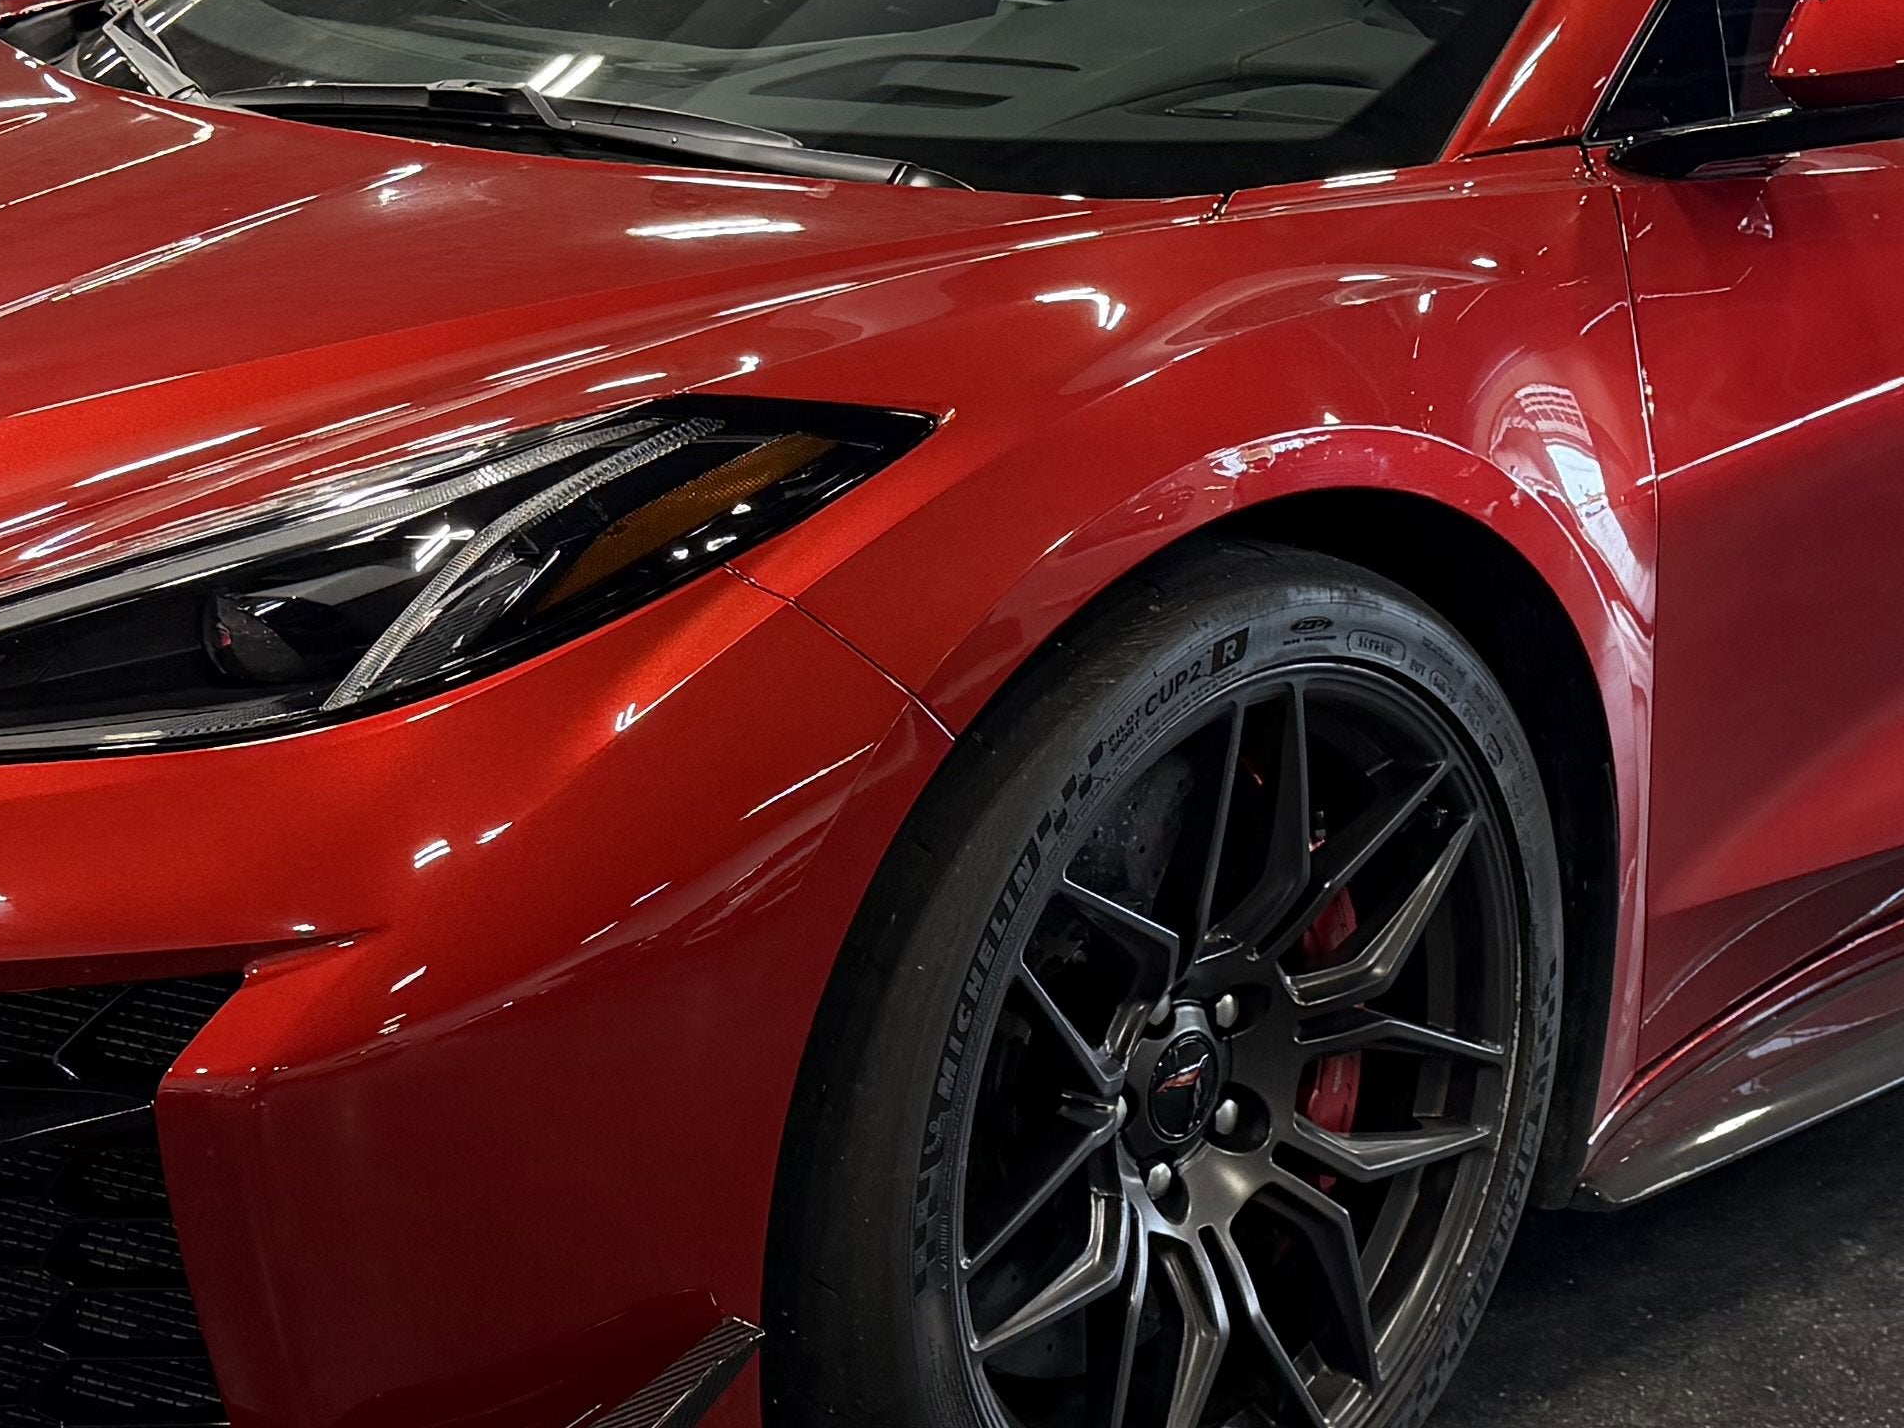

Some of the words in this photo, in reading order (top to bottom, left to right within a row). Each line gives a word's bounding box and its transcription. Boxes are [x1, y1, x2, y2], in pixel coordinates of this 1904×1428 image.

[1221, 638, 1238, 664] R
[1107, 705, 1142, 747] PILOT
[935, 852, 1035, 1101] MICHELIN
